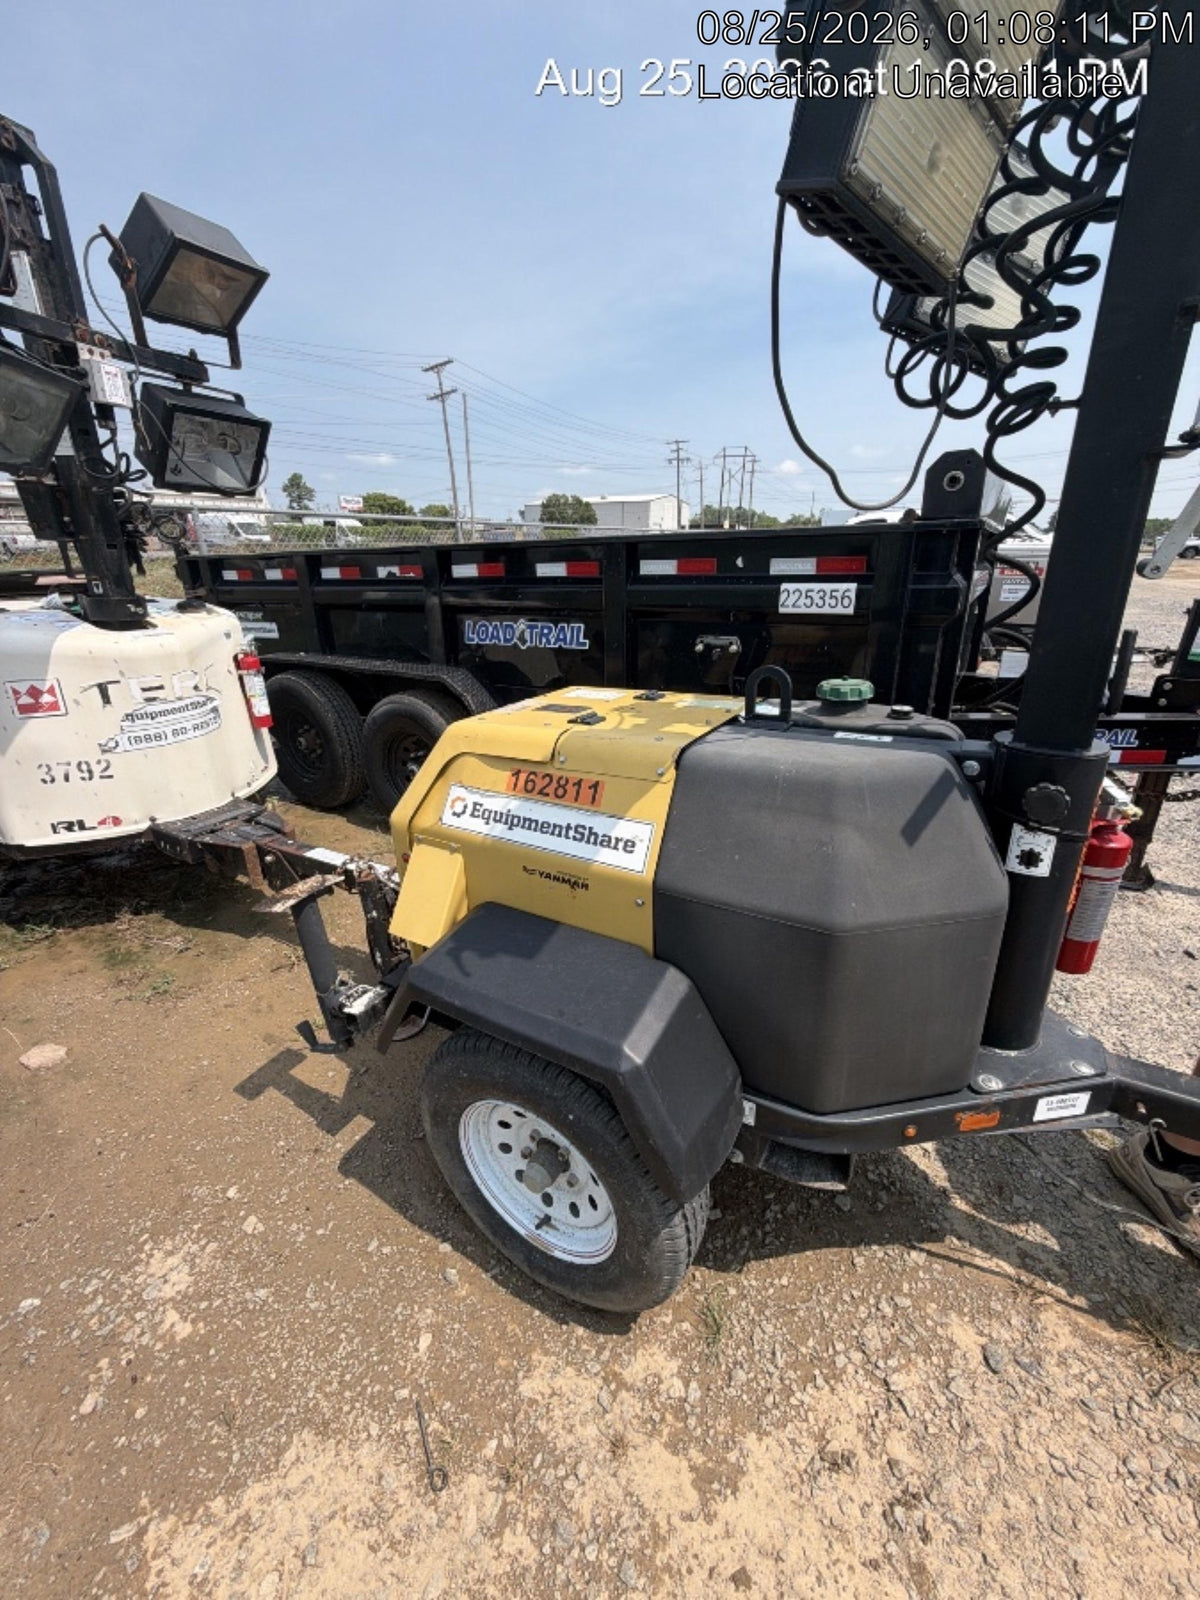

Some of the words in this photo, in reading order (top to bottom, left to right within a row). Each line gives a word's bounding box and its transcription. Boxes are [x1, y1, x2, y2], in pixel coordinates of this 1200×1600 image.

[779, 587, 853, 609] 225356
[465, 620, 518, 646] LOAD
[525, 621, 589, 650] TRAIL
[127, 730, 168, 746] (888)
[1093, 728, 1139, 748] RAIL
[37, 759, 114, 785] 3792
[511, 769, 600, 804] 162811
[469, 801, 637, 854] EquipmentShare
[538, 869, 590, 892] YANMAR
